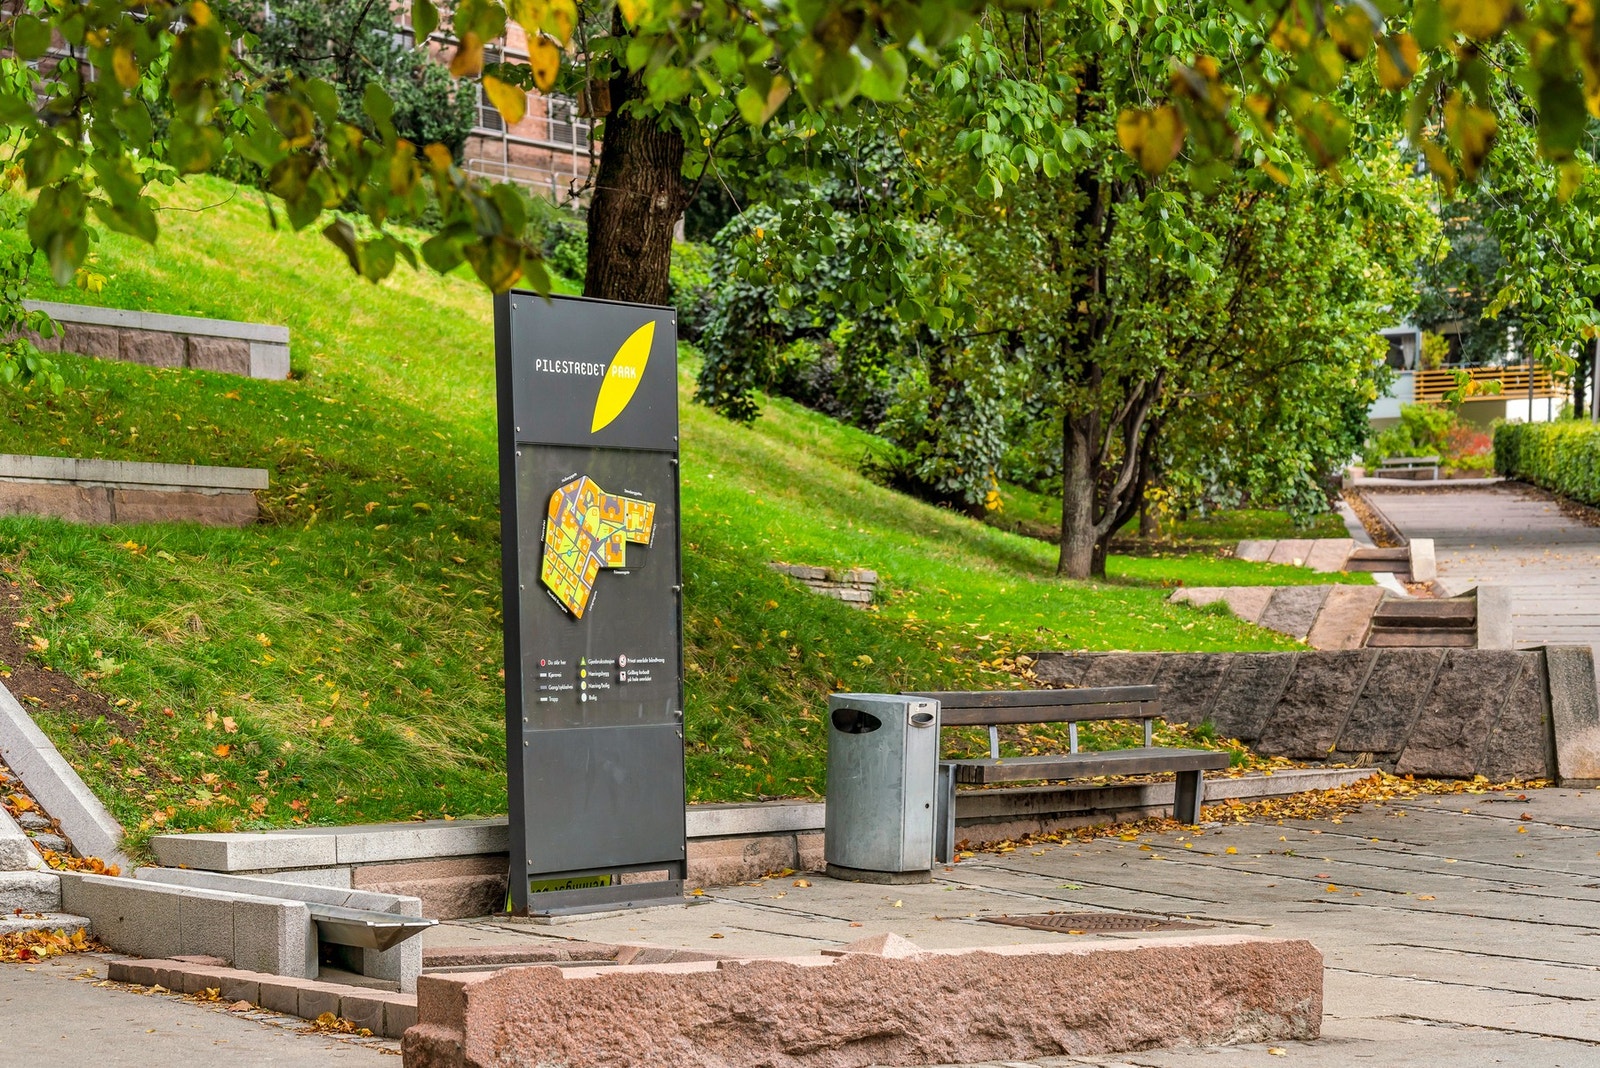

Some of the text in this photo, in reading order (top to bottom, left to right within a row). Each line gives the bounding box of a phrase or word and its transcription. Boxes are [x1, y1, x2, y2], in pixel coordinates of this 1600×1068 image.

[535, 358, 637, 379] PILESTREDET PARK
[549, 695, 559, 703] Trapp
